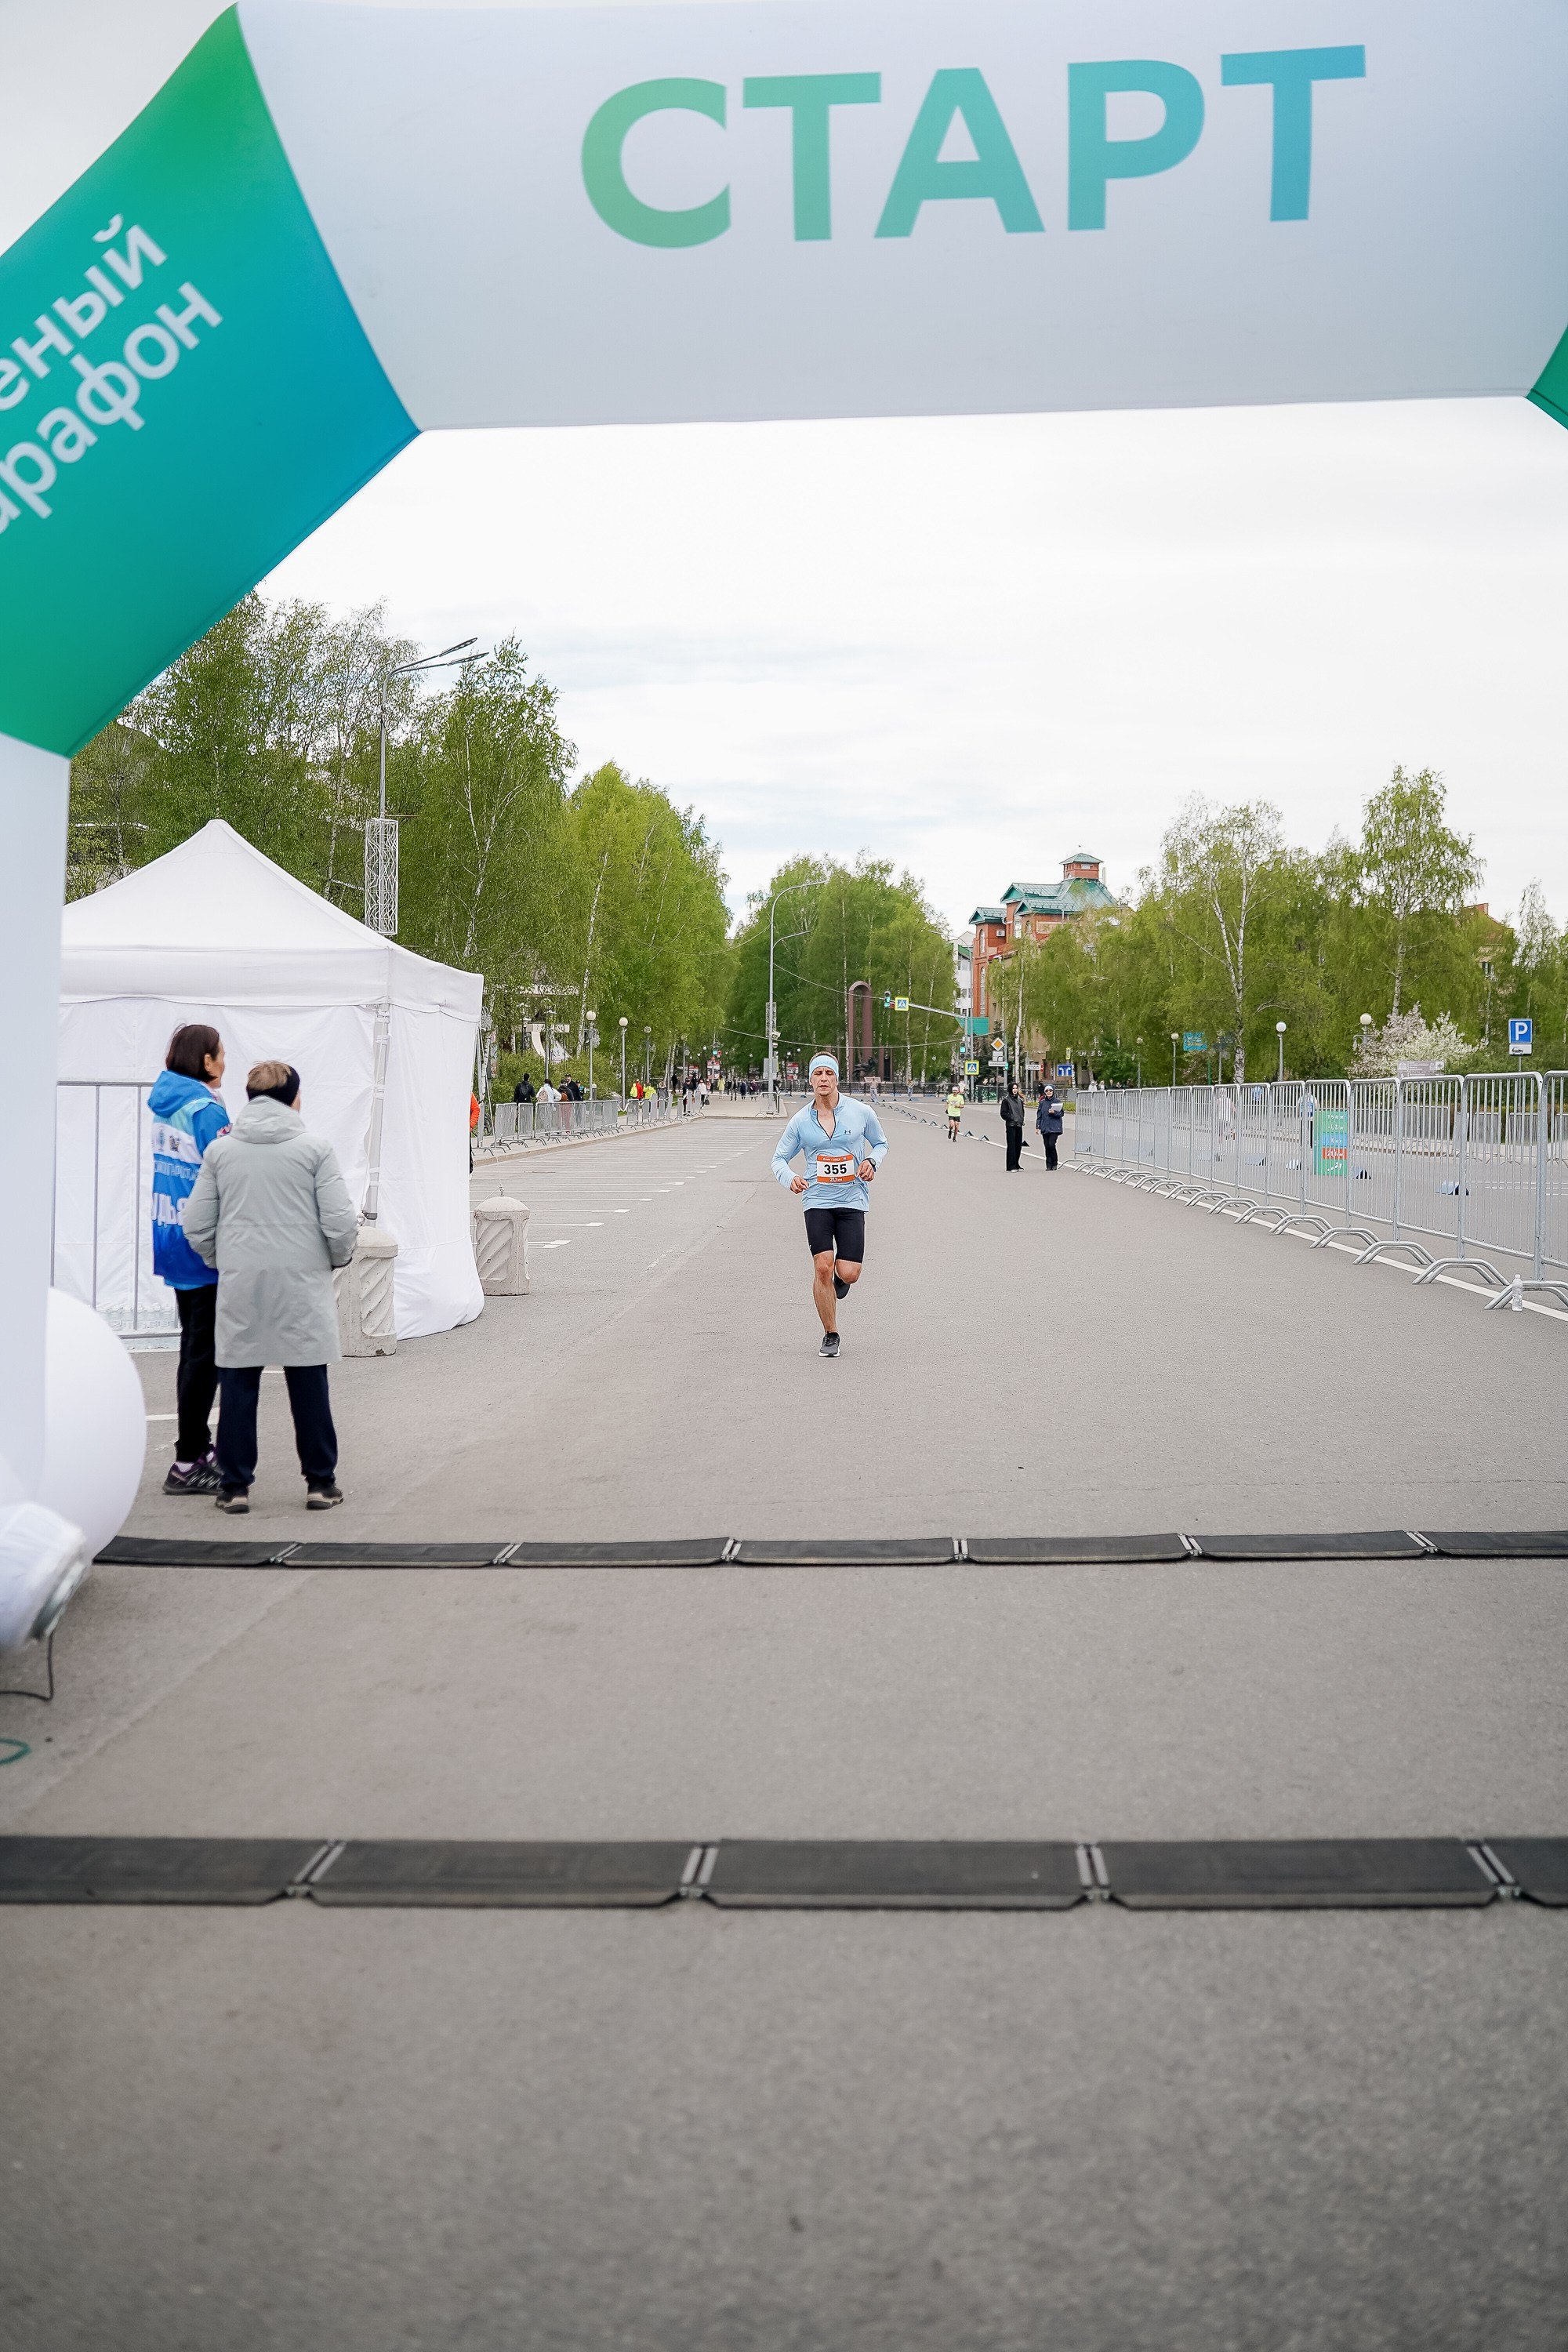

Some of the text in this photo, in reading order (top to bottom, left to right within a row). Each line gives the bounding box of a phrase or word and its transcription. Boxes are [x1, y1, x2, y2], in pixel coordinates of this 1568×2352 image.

[581, 45, 1367, 249] СТАРТ
[1515, 1022, 1528, 1041] P
[824, 1163, 847, 1174] 355
